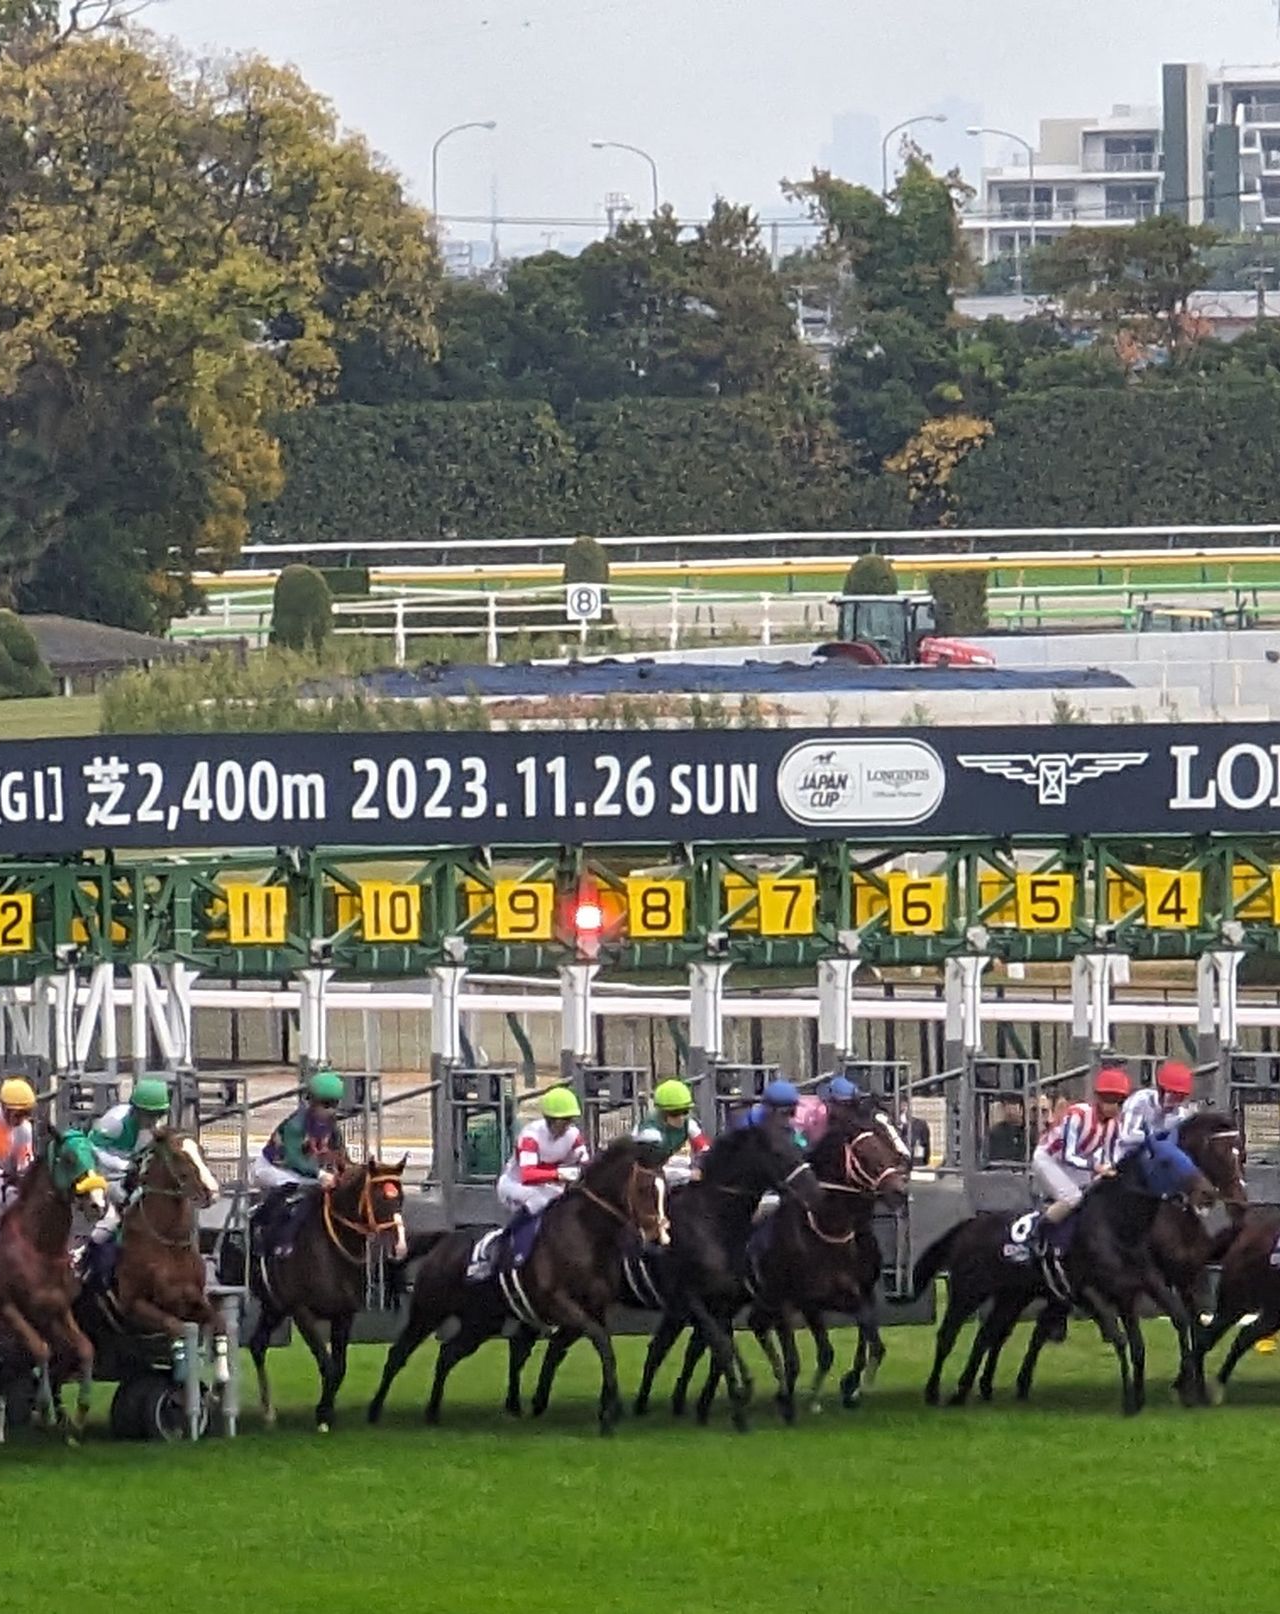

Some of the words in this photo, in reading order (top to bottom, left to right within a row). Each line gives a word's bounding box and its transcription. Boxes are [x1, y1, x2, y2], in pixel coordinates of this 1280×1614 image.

[351, 755, 656, 819] 2023.11.26
[669, 762, 759, 815] SUN
[798, 773, 849, 791] JAPAN
[809, 791, 841, 808] CUP
[242, 892, 273, 938] 11
[374, 890, 411, 935] 10
[508, 889, 539, 933] 9
[641, 887, 671, 931] 8
[772, 885, 801, 930] 7
[902, 882, 932, 927] 6
[1030, 879, 1060, 924] 5
[1157, 877, 1189, 923] 4
